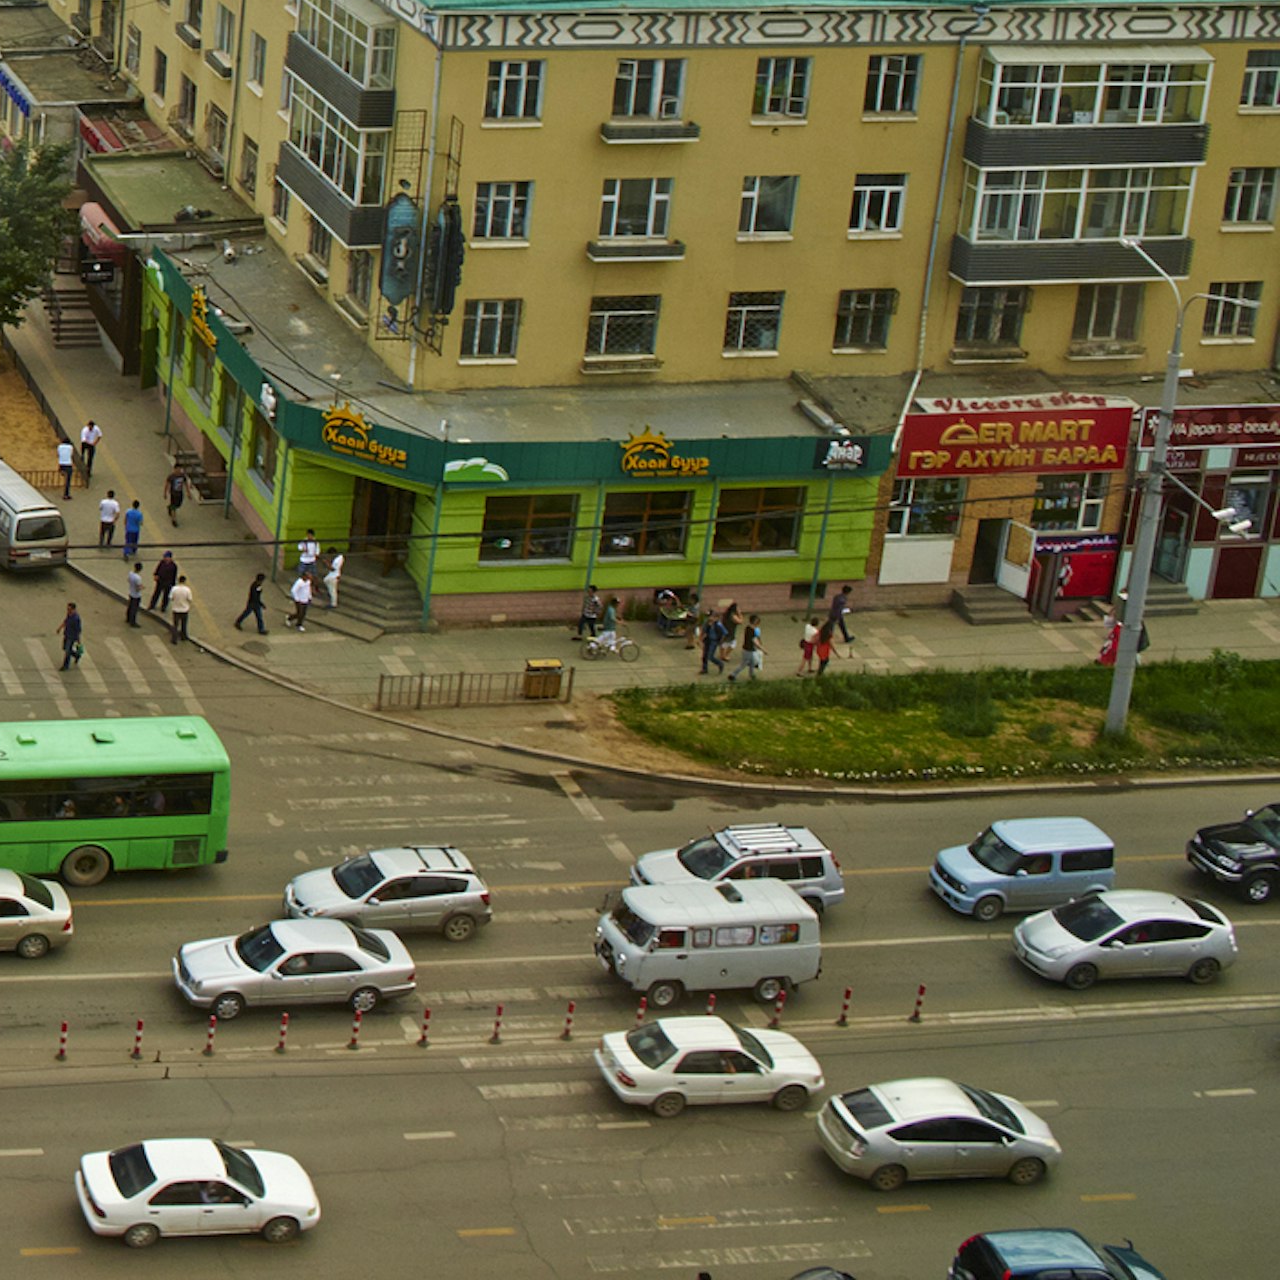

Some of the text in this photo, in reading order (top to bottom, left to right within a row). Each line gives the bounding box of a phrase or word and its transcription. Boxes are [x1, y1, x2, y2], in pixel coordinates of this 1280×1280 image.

[1018, 420, 1095, 442] MART
[626, 455, 710, 473] Хаан бууз
[908, 444, 1118, 470] ГЭР АХУЙН БАРАА
